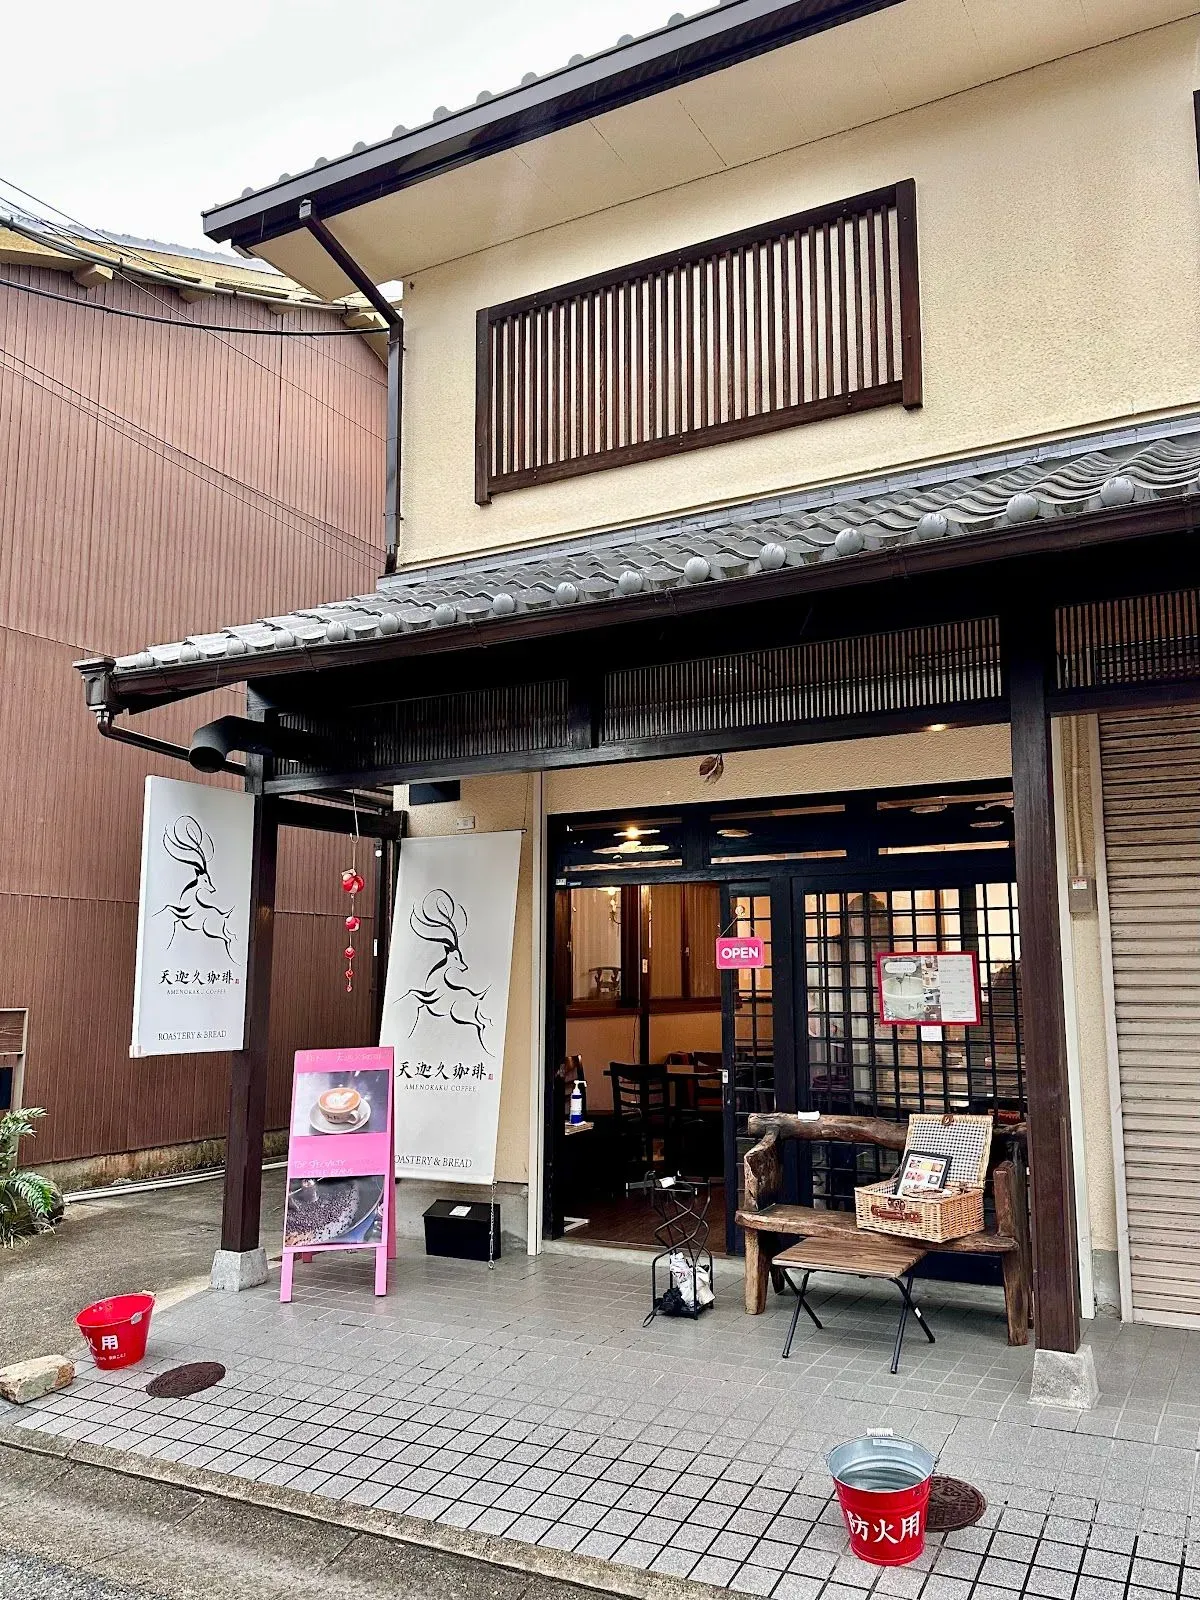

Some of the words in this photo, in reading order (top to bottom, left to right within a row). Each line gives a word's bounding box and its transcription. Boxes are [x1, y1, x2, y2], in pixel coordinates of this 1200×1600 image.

[721, 946, 759, 960] OPEN
[158, 969, 234, 985] 天迦久珈琲
[158, 1031, 195, 1041] ROASTERY
[196, 1031, 203, 1039] &
[203, 1030, 226, 1039] BREAD
[396, 1061, 487, 1080] 天迦久珈琲
[404, 1083, 449, 1091] AMENOKAKU
[433, 1156, 441, 1166] &
[442, 1157, 472, 1168] BREAD
[845, 1508, 920, 1544] 防火用
